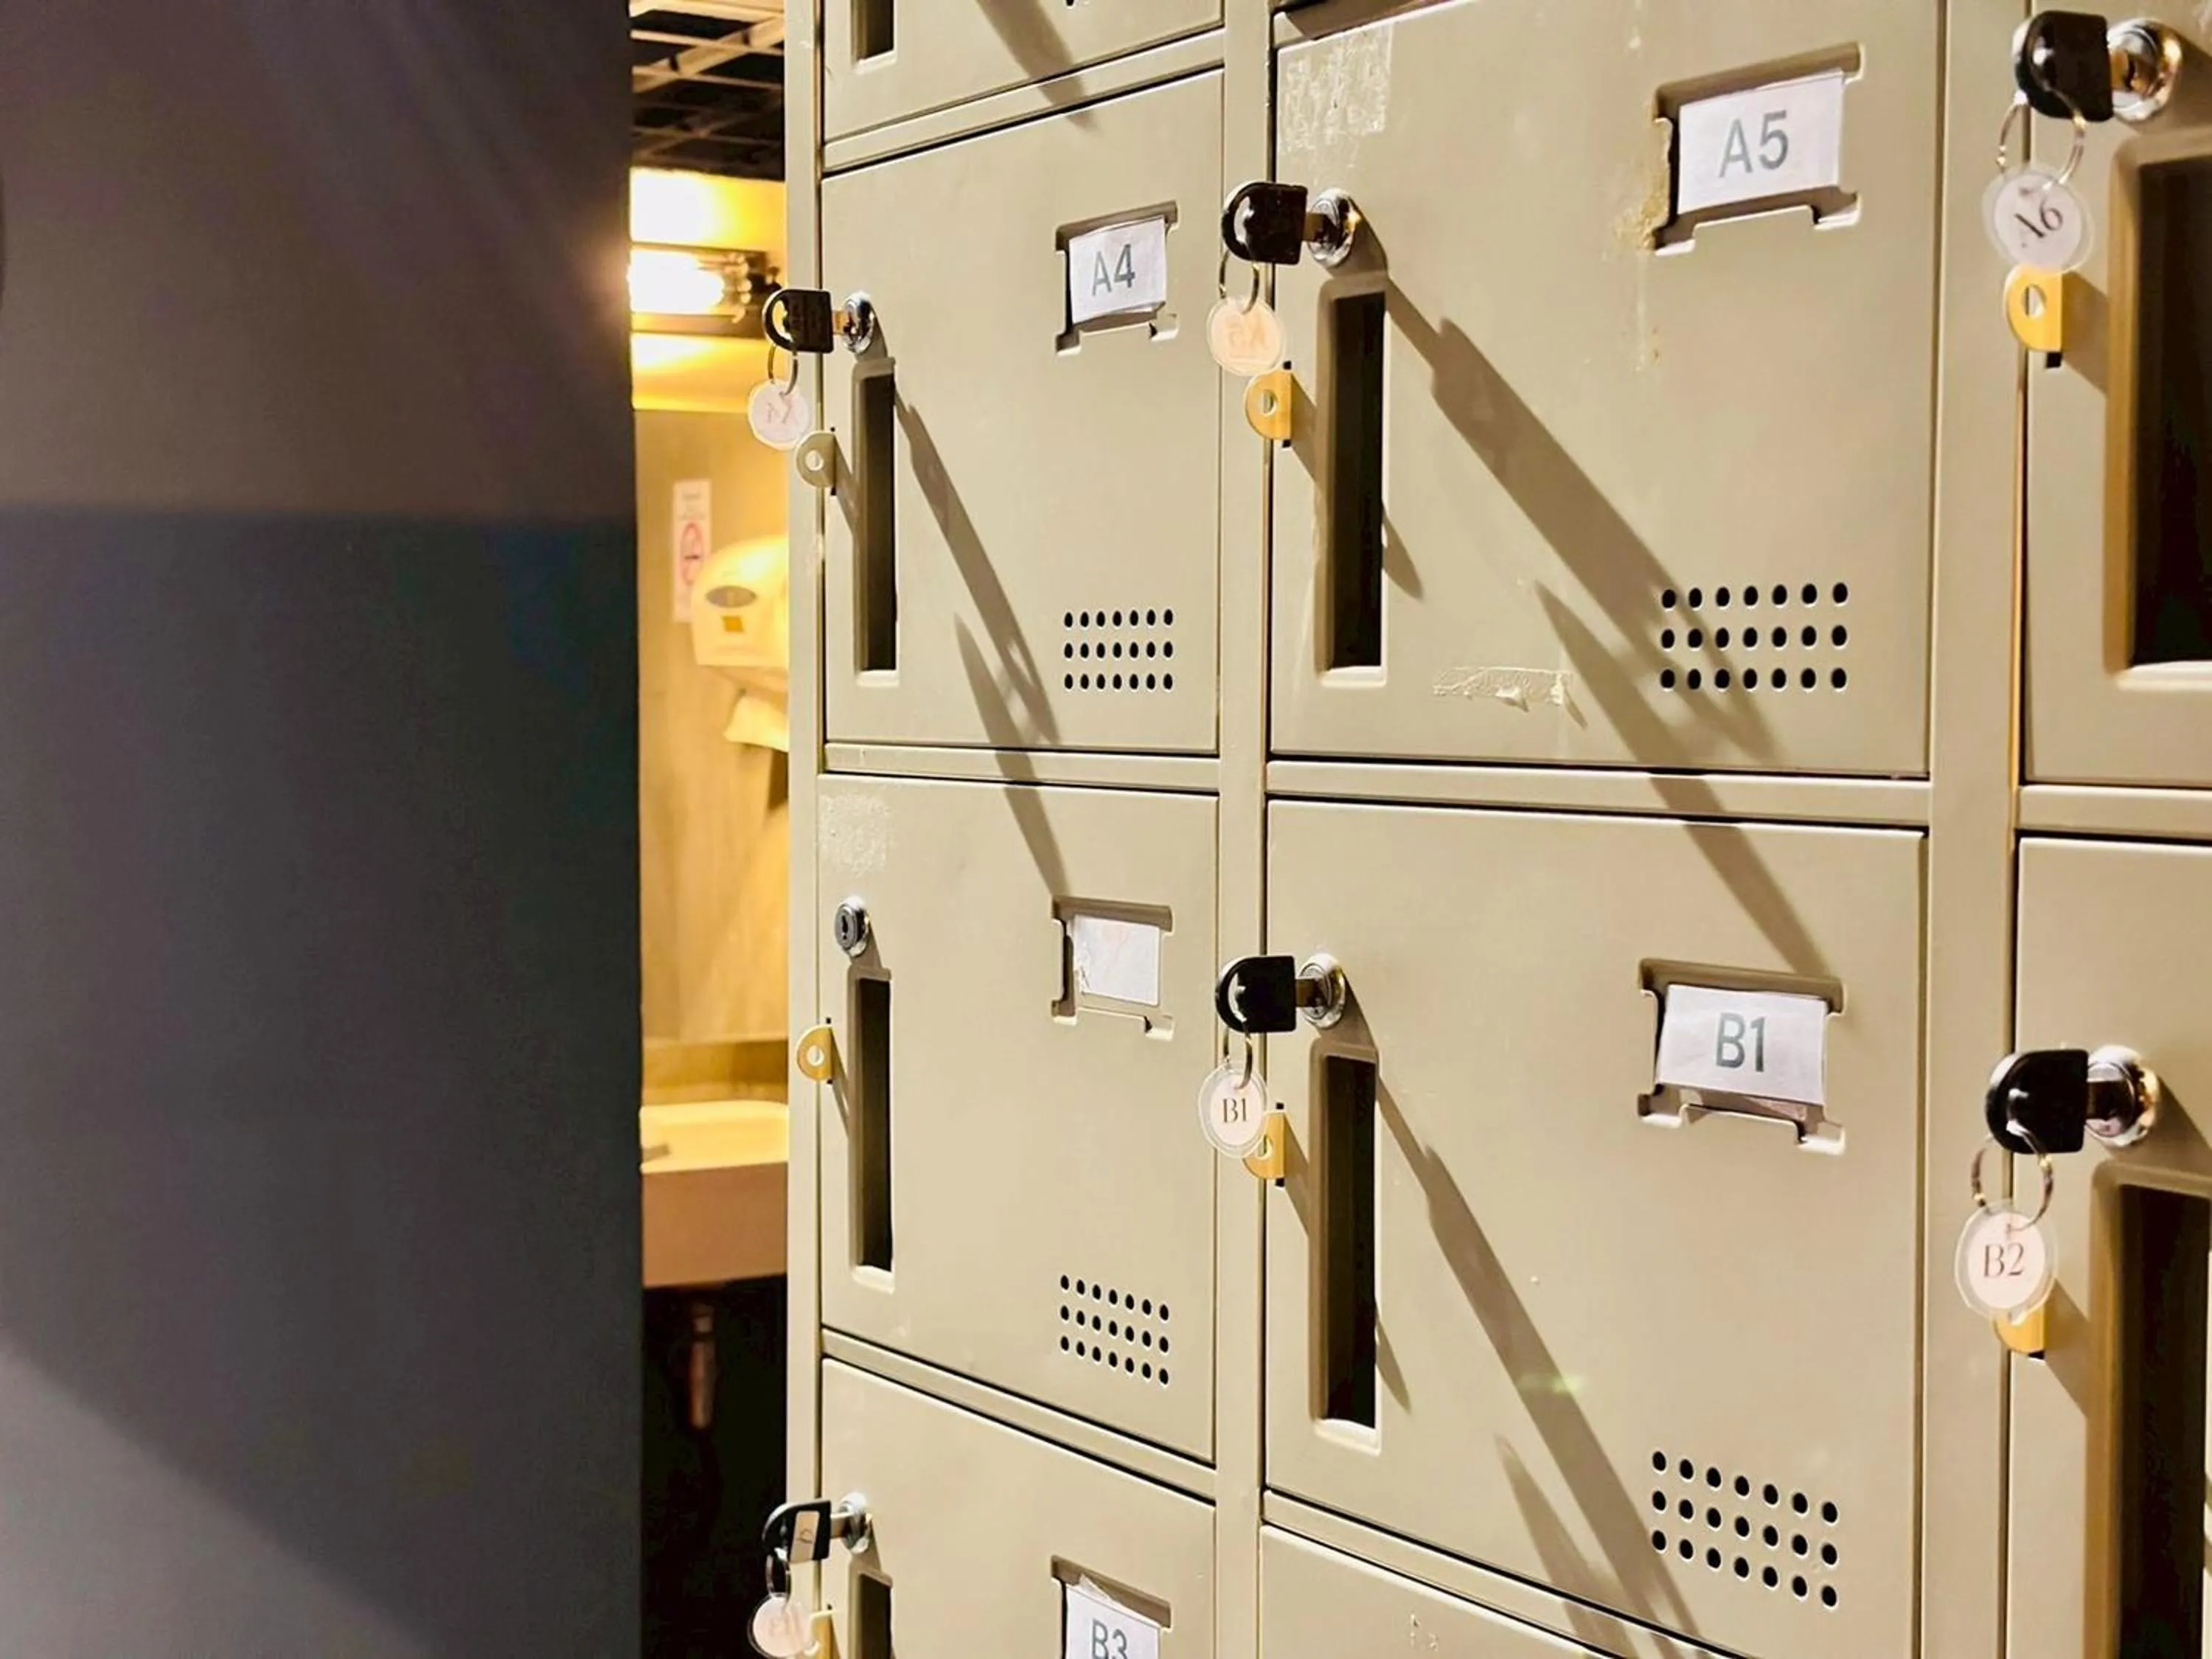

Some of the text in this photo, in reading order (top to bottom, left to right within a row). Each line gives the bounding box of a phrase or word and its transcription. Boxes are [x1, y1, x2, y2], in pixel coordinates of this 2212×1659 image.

[1718, 110, 1789, 178] A5
[1092, 243, 1135, 296] A4
[1716, 1012, 1766, 1073] B1
[1222, 1097, 1247, 1123] B1
[1983, 1242, 2025, 1278] B2
[1091, 1618, 1128, 1659] B3
